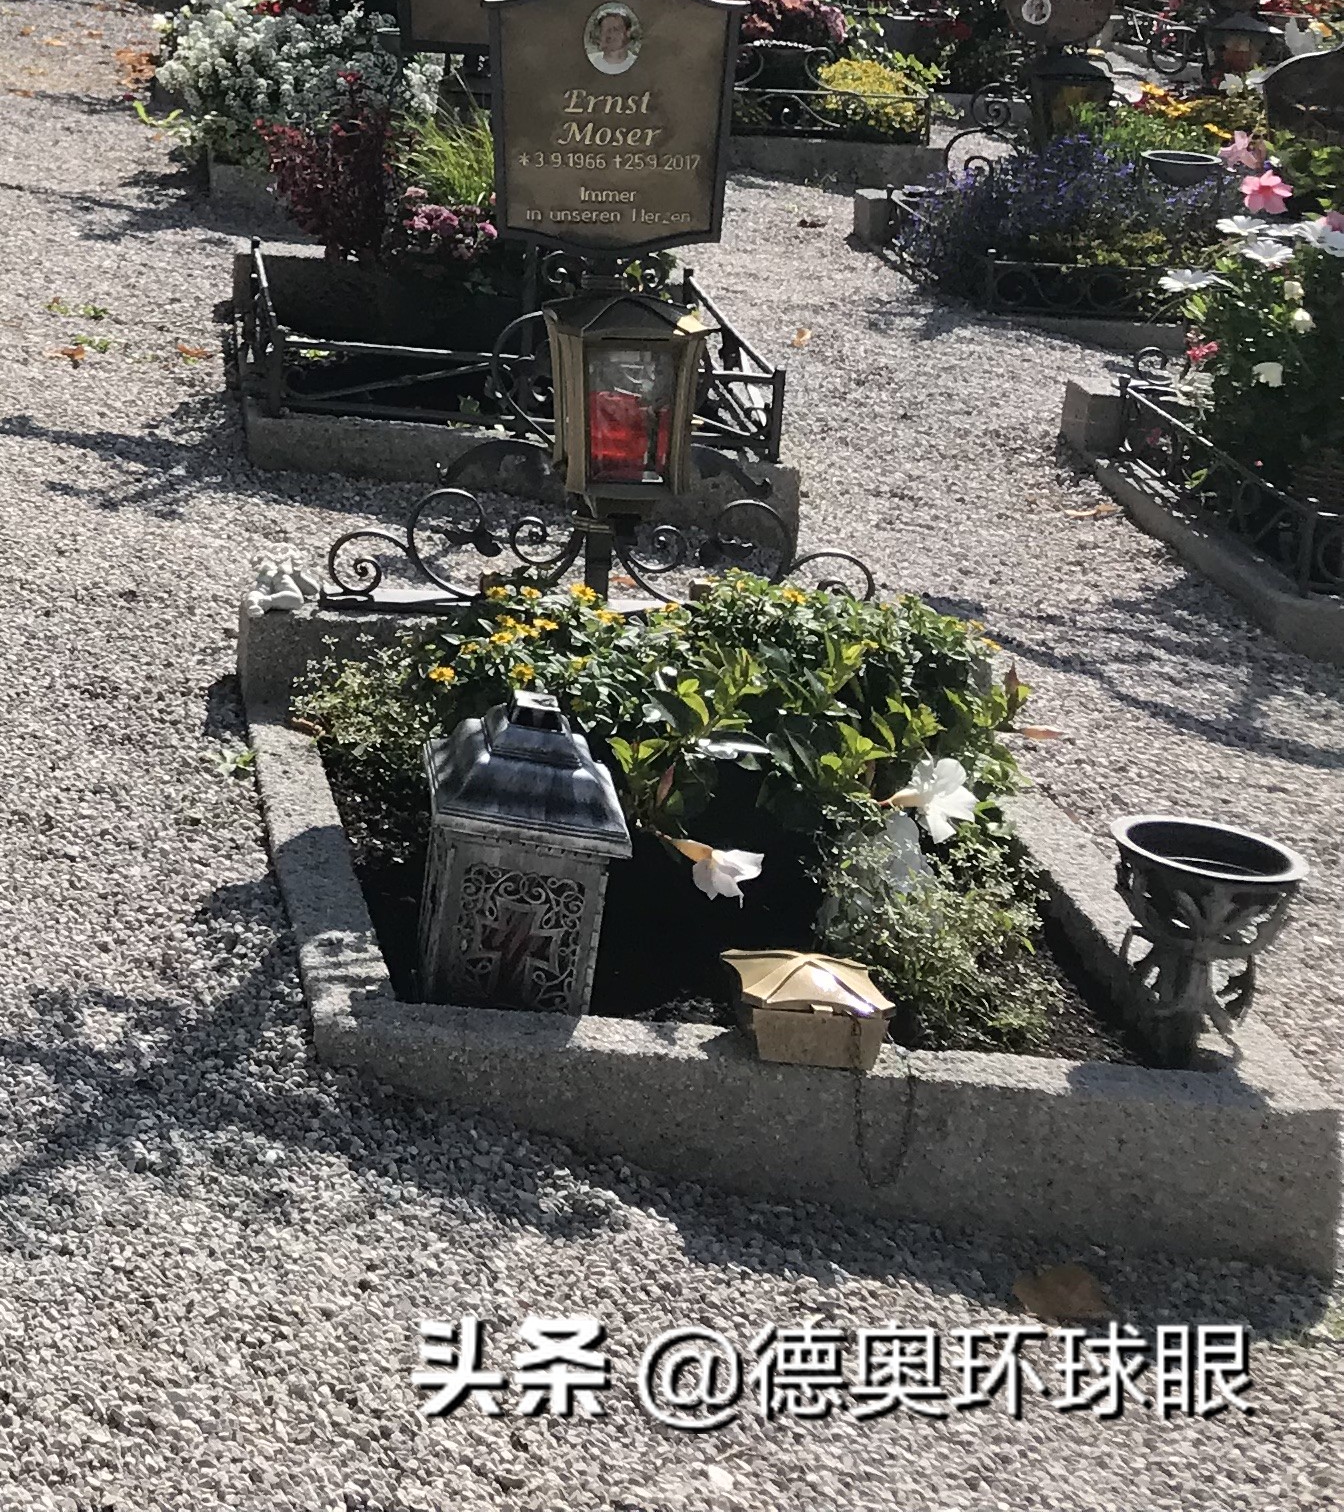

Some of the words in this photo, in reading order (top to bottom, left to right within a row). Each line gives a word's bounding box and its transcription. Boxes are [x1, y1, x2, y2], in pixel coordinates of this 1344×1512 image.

[564, 89, 652, 114] Ernst
[557, 121, 662, 146] Moser
[580, 186, 637, 202] Immer
[526, 207, 542, 221] in
[549, 207, 620, 222] unseren
